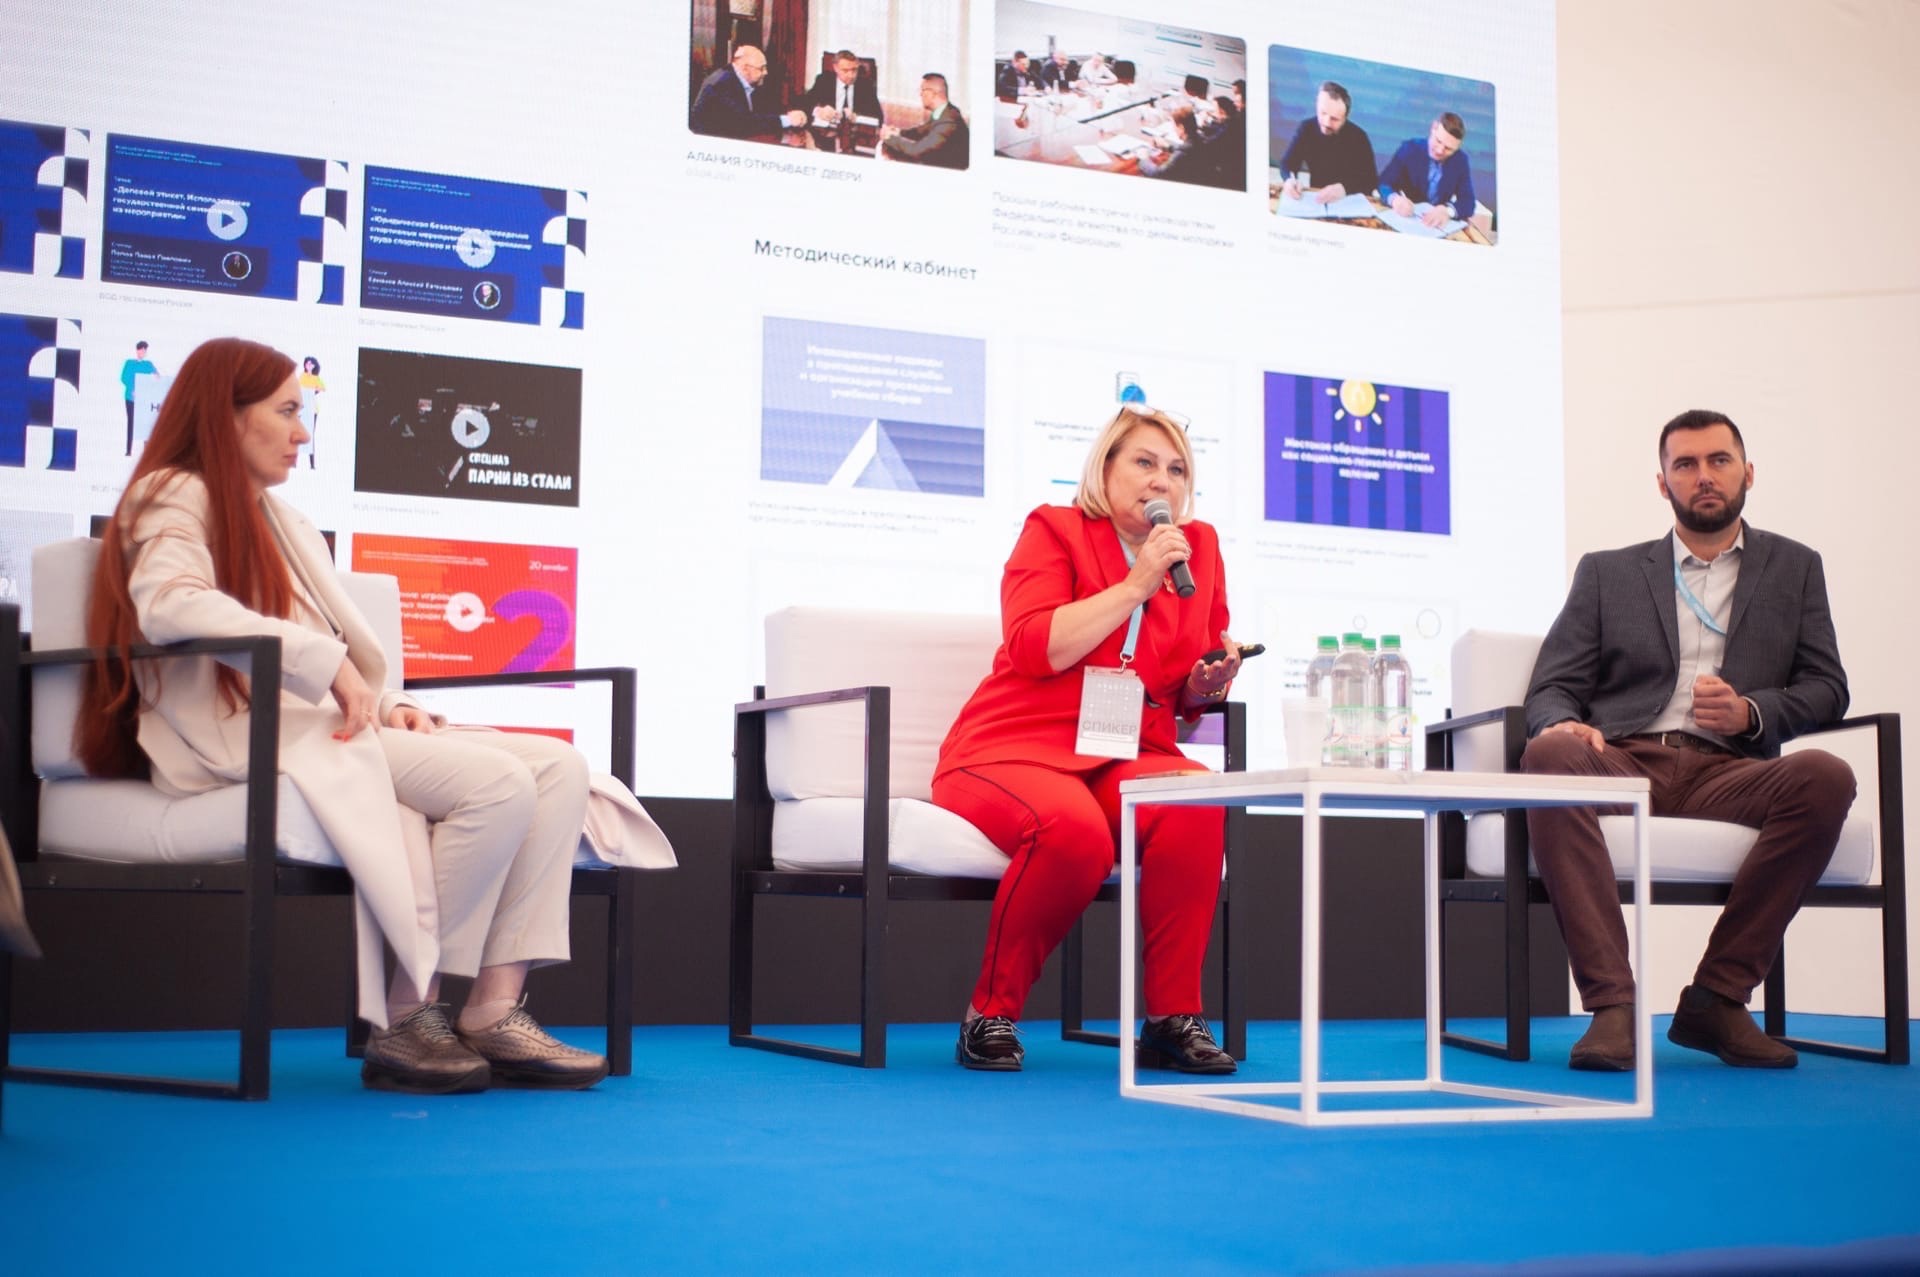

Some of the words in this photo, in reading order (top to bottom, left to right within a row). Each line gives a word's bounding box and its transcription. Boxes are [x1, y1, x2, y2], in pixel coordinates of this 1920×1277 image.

[687, 151, 741, 167] АЛАНИЯ
[744, 159, 816, 176] ОТКРЫВАЕТ
[821, 168, 862, 182] ДВЕРИ
[754, 239, 896, 270] Методический
[903, 259, 977, 280] кабинет
[469, 452, 509, 466] СПЕЦНАЗ
[468, 469, 511, 485] ПАРНИ
[512, 472, 530, 487] ИЗ
[531, 474, 572, 490] СТАЛИ
[528, 559, 542, 571] 20
[1083, 720, 1137, 735] СПИКЕР
